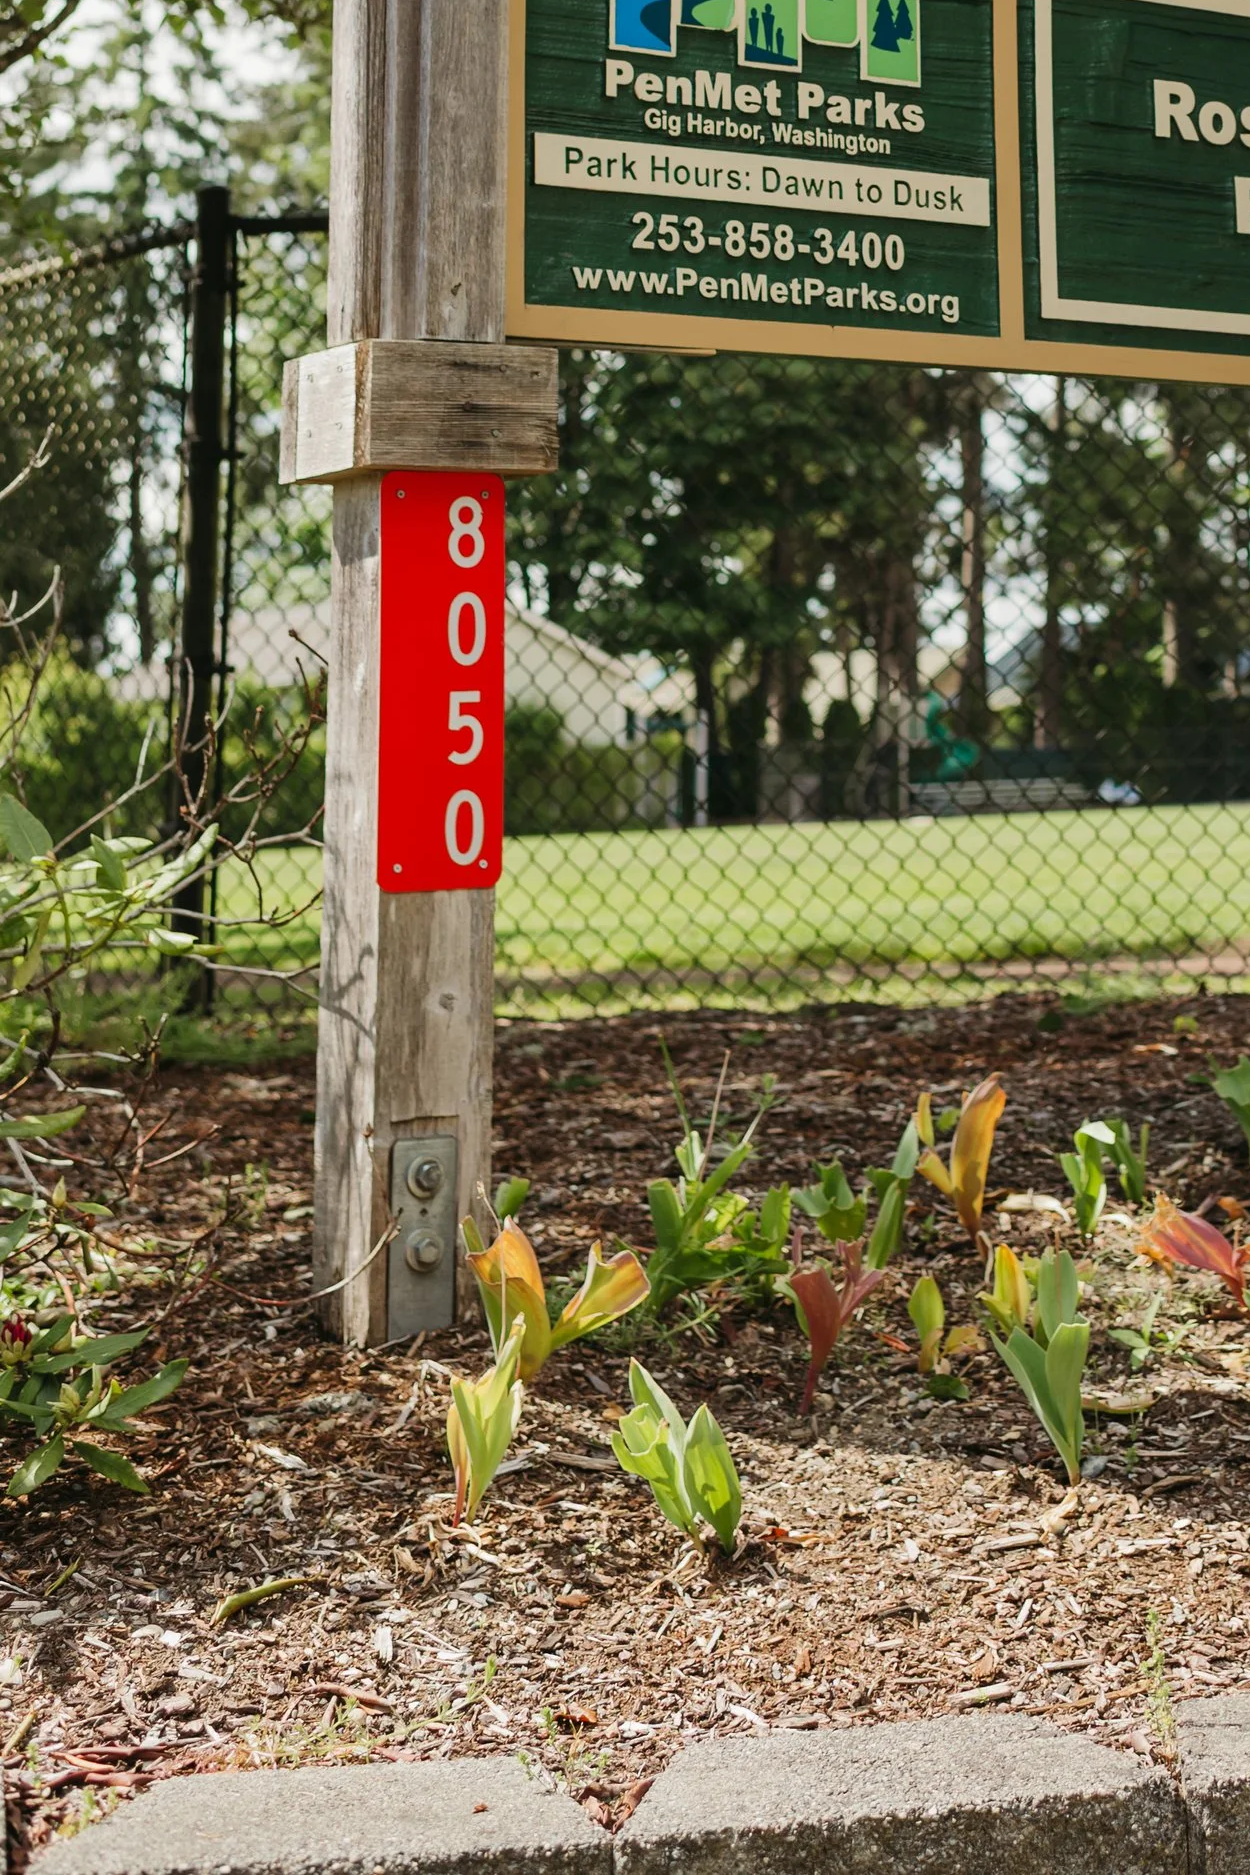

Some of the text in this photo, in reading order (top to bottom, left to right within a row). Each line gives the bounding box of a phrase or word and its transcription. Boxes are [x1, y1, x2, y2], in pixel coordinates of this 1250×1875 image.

[605, 58, 925, 132] PenMet Parks
[644, 108, 891, 155] Gig Harbor, Washington
[565, 147, 965, 212] Park Hours: Dawn to Dusk
[632, 212, 905, 271] 253-858-3400
[573, 265, 960, 322] www.PenMetParks.org
[444, 496, 486, 866] 8050
